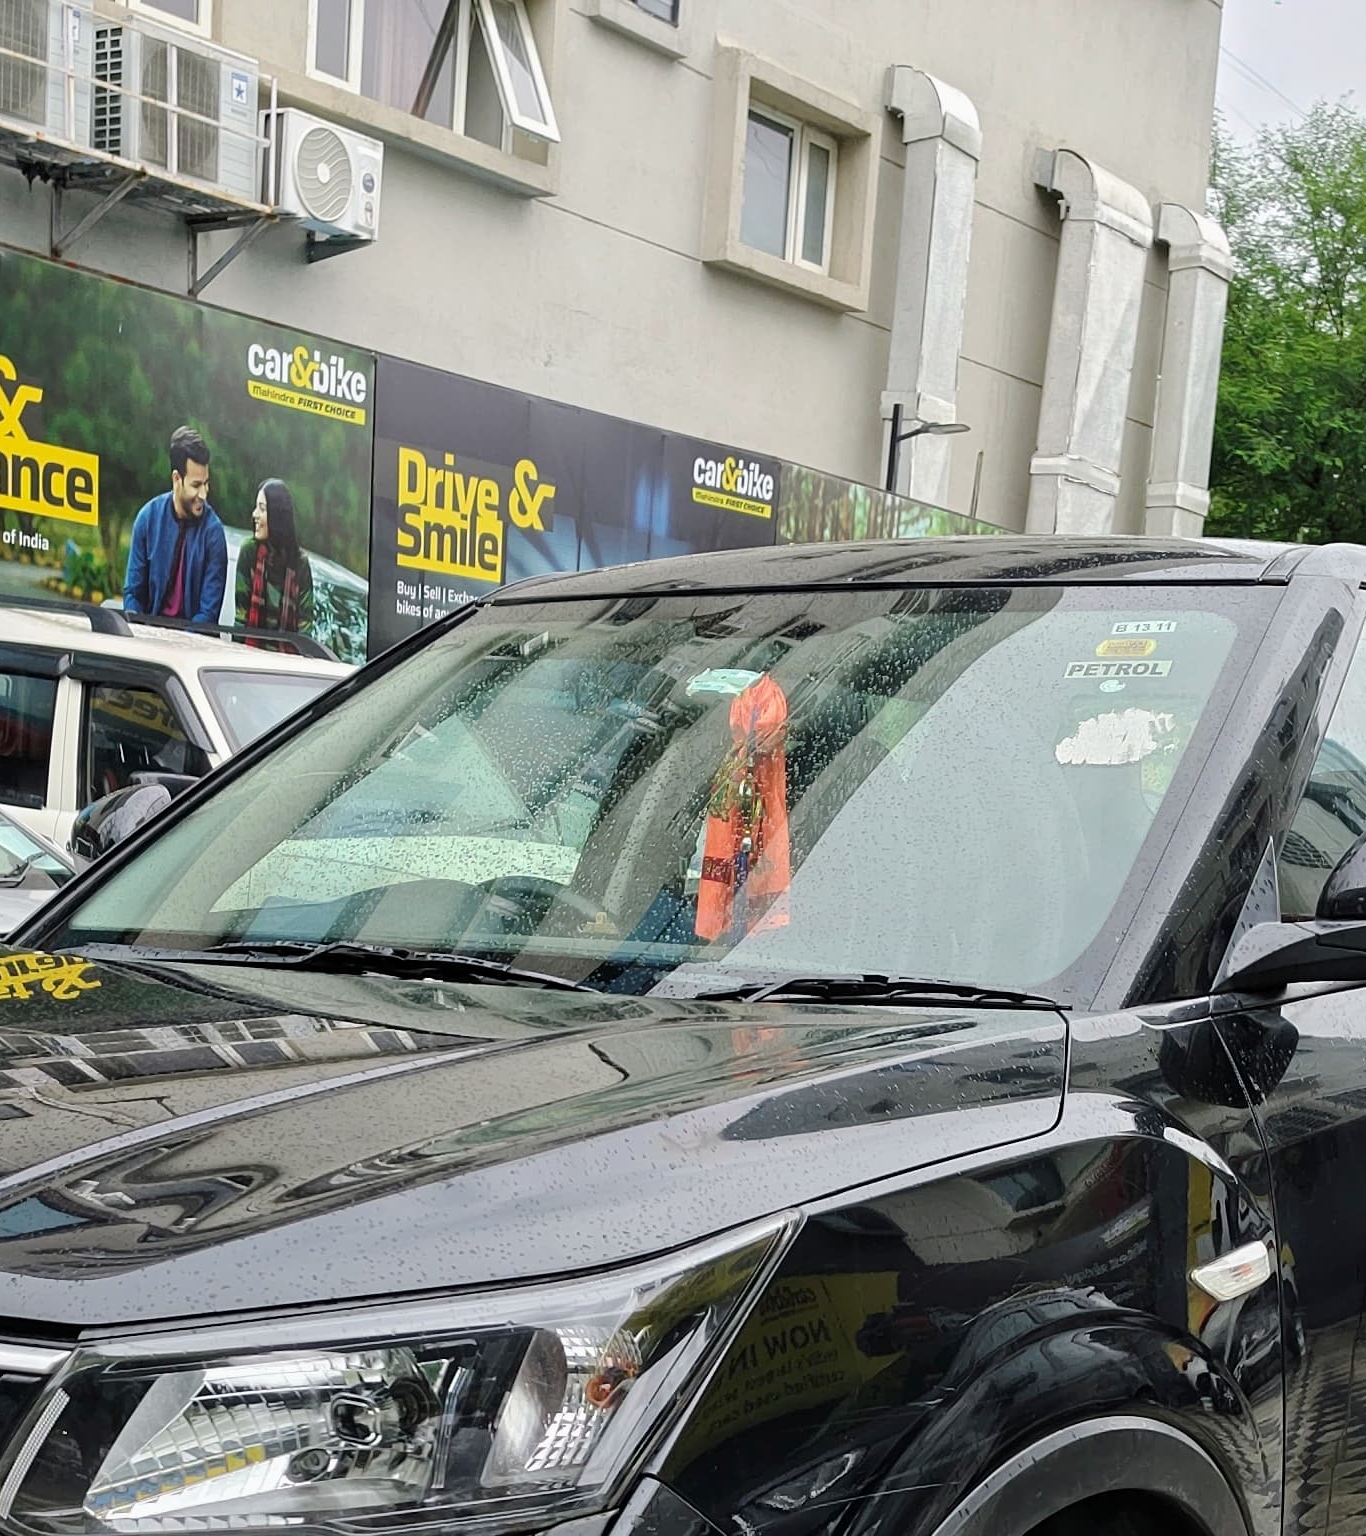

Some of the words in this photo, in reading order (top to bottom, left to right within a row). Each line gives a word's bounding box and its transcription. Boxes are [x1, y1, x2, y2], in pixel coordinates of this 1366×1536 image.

[247, 343, 367, 403] car&bike
[297, 397, 324, 412] FIRST
[324, 404, 357, 420] CHOICE
[398, 446, 500, 518] Drive
[508, 458, 557, 532] &
[693, 456, 774, 501] car&bike
[2, 529, 17, 545] of
[18, 530, 49, 551] India
[397, 503, 499, 572] Smile
[396, 580, 417, 601] Buy
[423, 584, 441, 603] Sell
[447, 589, 482, 605] Excha
[396, 599, 421, 618] bikes
[422, 603, 434, 620] of
[1066, 662, 1165, 677] PETROL
